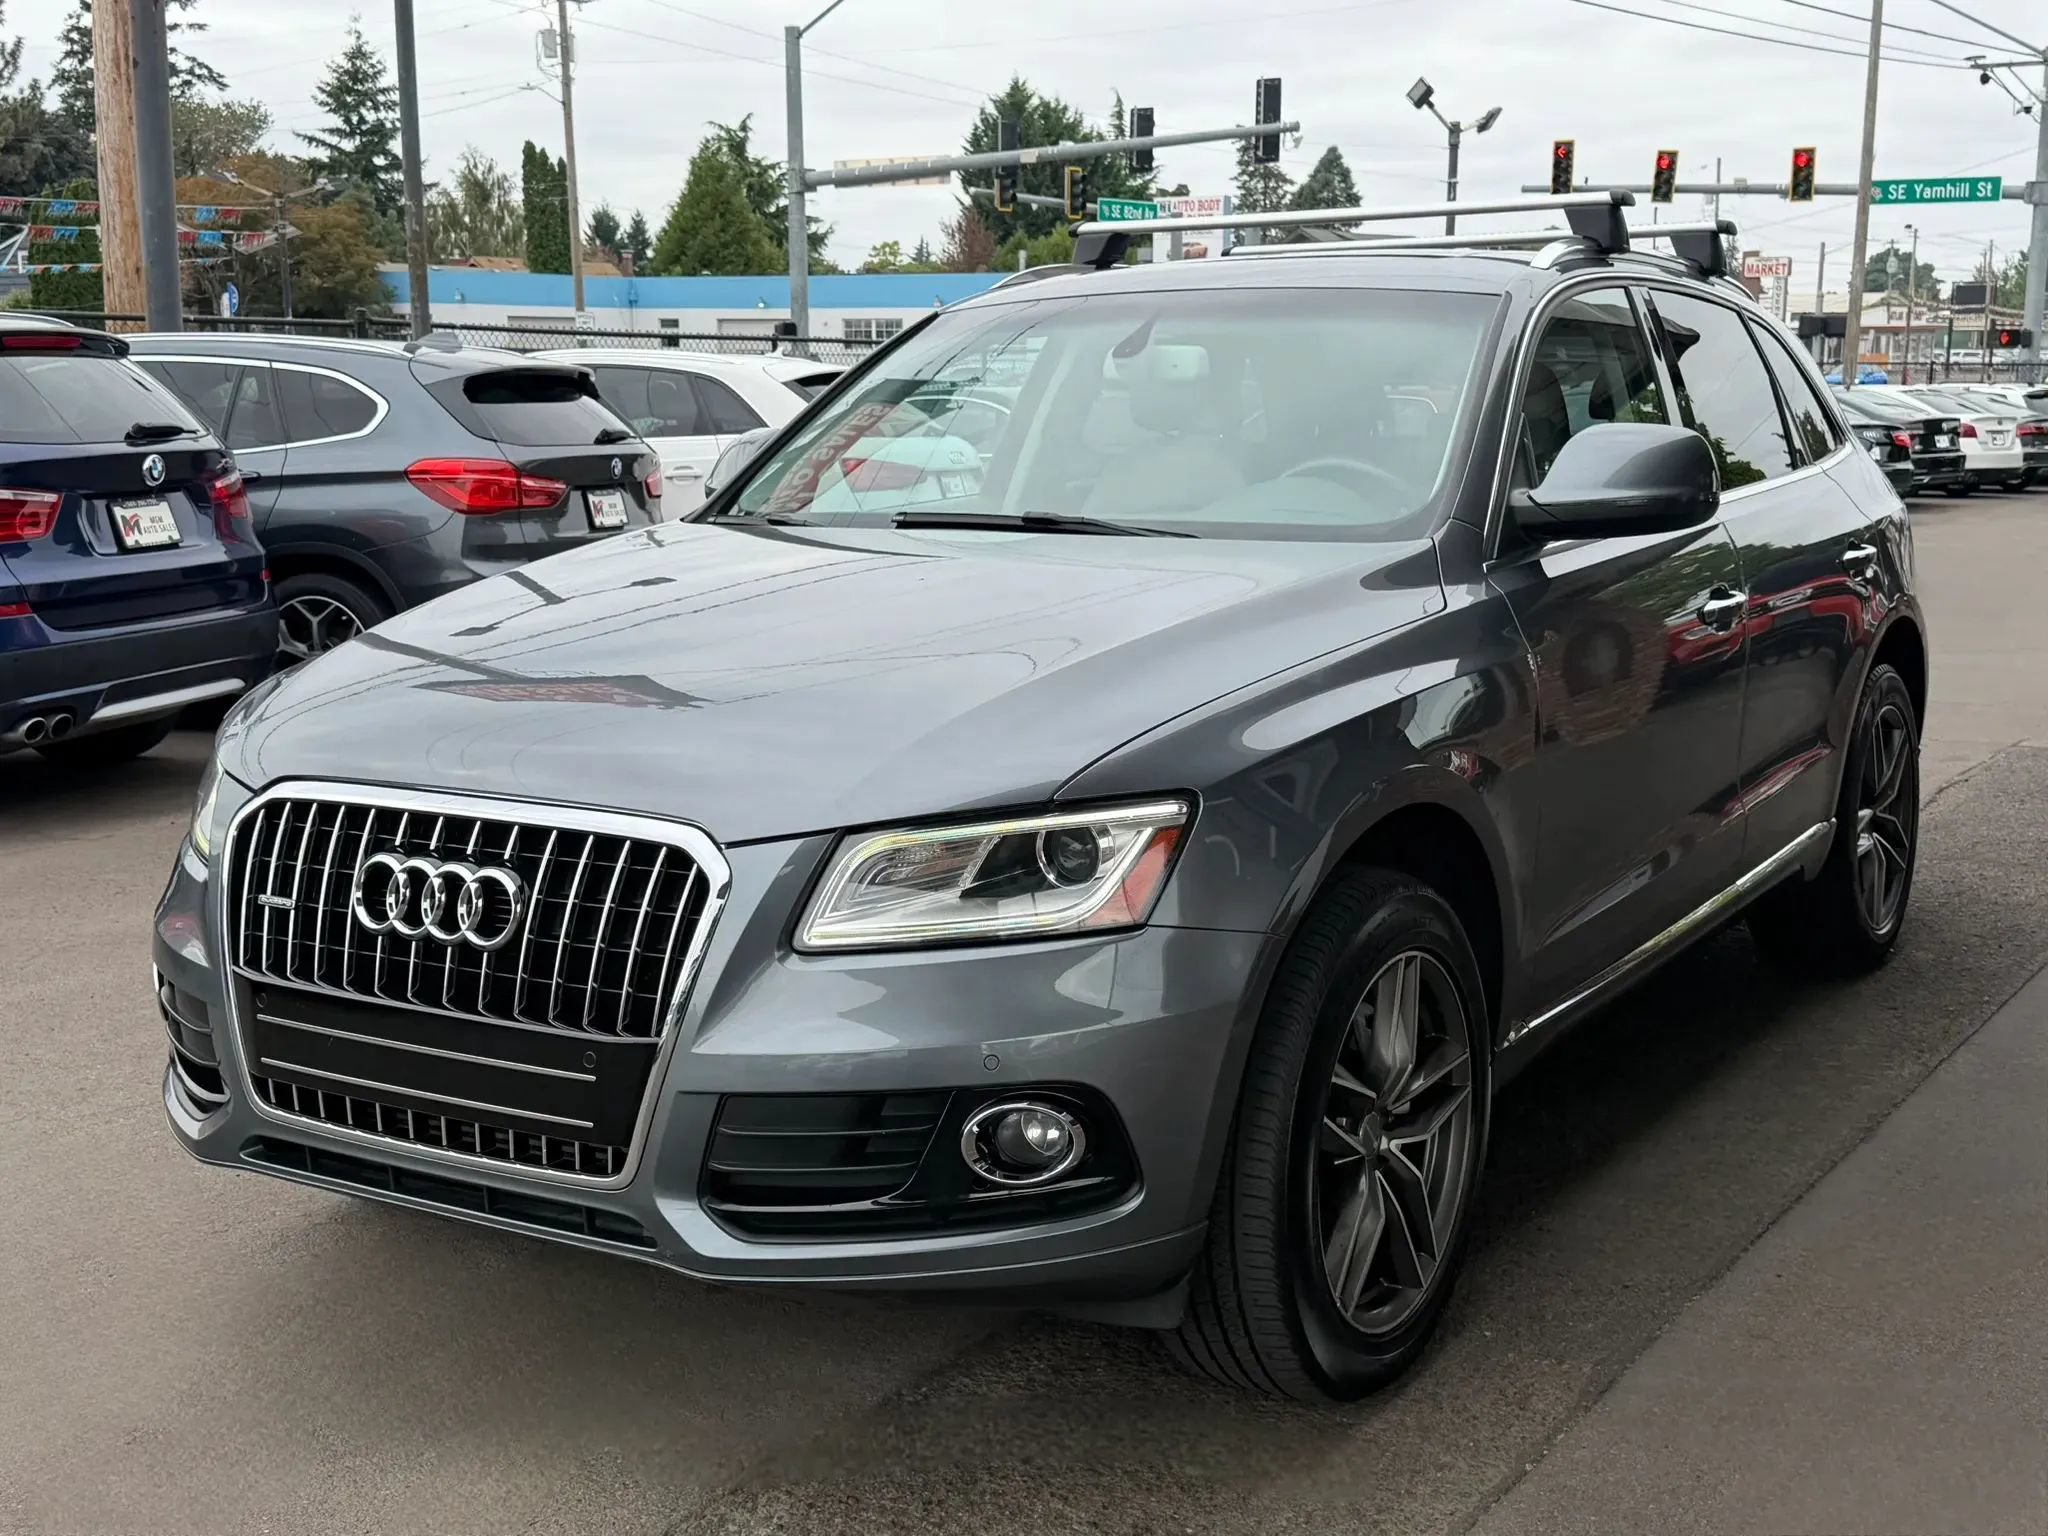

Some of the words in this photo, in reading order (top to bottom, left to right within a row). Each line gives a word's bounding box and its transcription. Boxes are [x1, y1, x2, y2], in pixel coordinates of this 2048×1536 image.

[1888, 184, 1907, 200] SE
[1914, 182, 1970, 199] Yamhill
[1976, 181, 1993, 198] St
[1111, 204, 1121, 218] SE
[1124, 206, 1142, 220] 82nd
[1173, 200, 1196, 213] AUTO
[1198, 199, 1221, 212] BODY
[1747, 263, 1787, 276] MARKET
